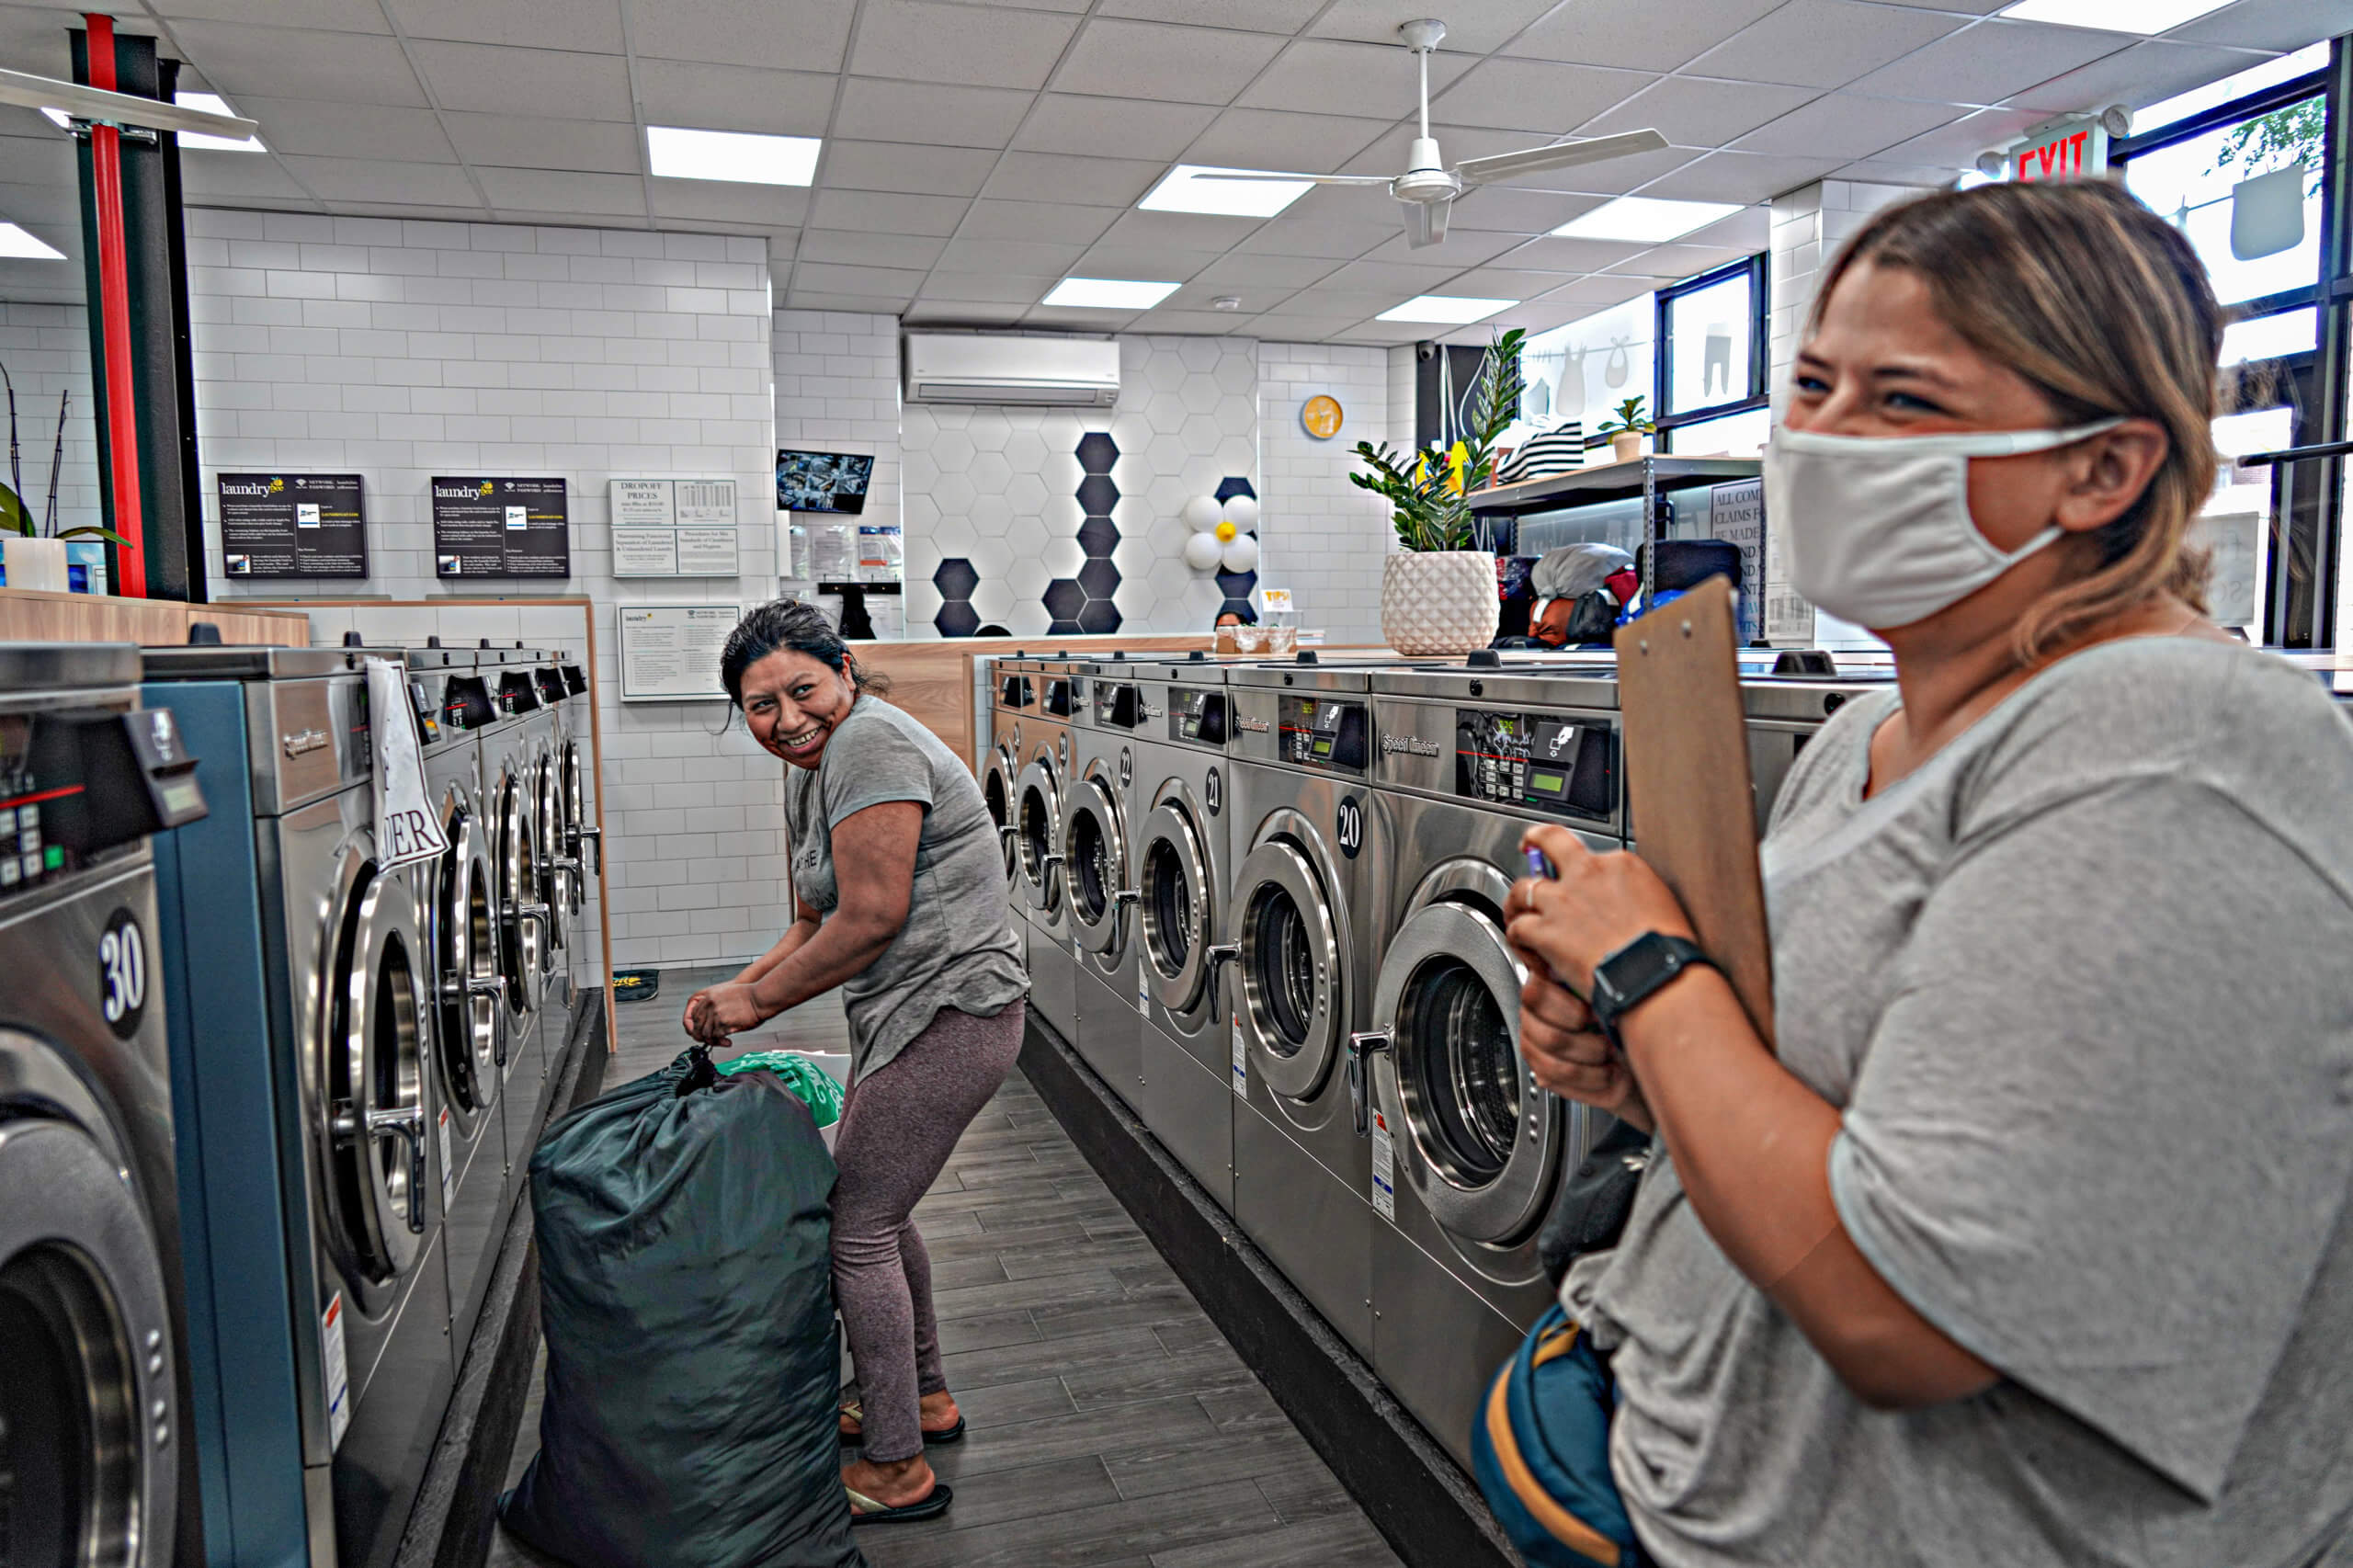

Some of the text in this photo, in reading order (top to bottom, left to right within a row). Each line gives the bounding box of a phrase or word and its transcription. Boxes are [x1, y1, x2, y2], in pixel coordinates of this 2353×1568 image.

[2018, 131, 2088, 183] EXIT
[221, 482, 270, 498] laundry
[434, 485, 481, 500] laundry
[627, 492, 658, 500] PRICES
[1716, 492, 1733, 506] ALL
[1714, 508, 1751, 525] CLAIMS
[1059, 736, 1067, 761] 23
[1382, 734, 1408, 754] Speed
[1121, 752, 1131, 780] 22
[1208, 773, 1220, 807] 21
[381, 810, 441, 864] DER
[1339, 804, 1360, 847] 20
[101, 923, 145, 1022] 30
